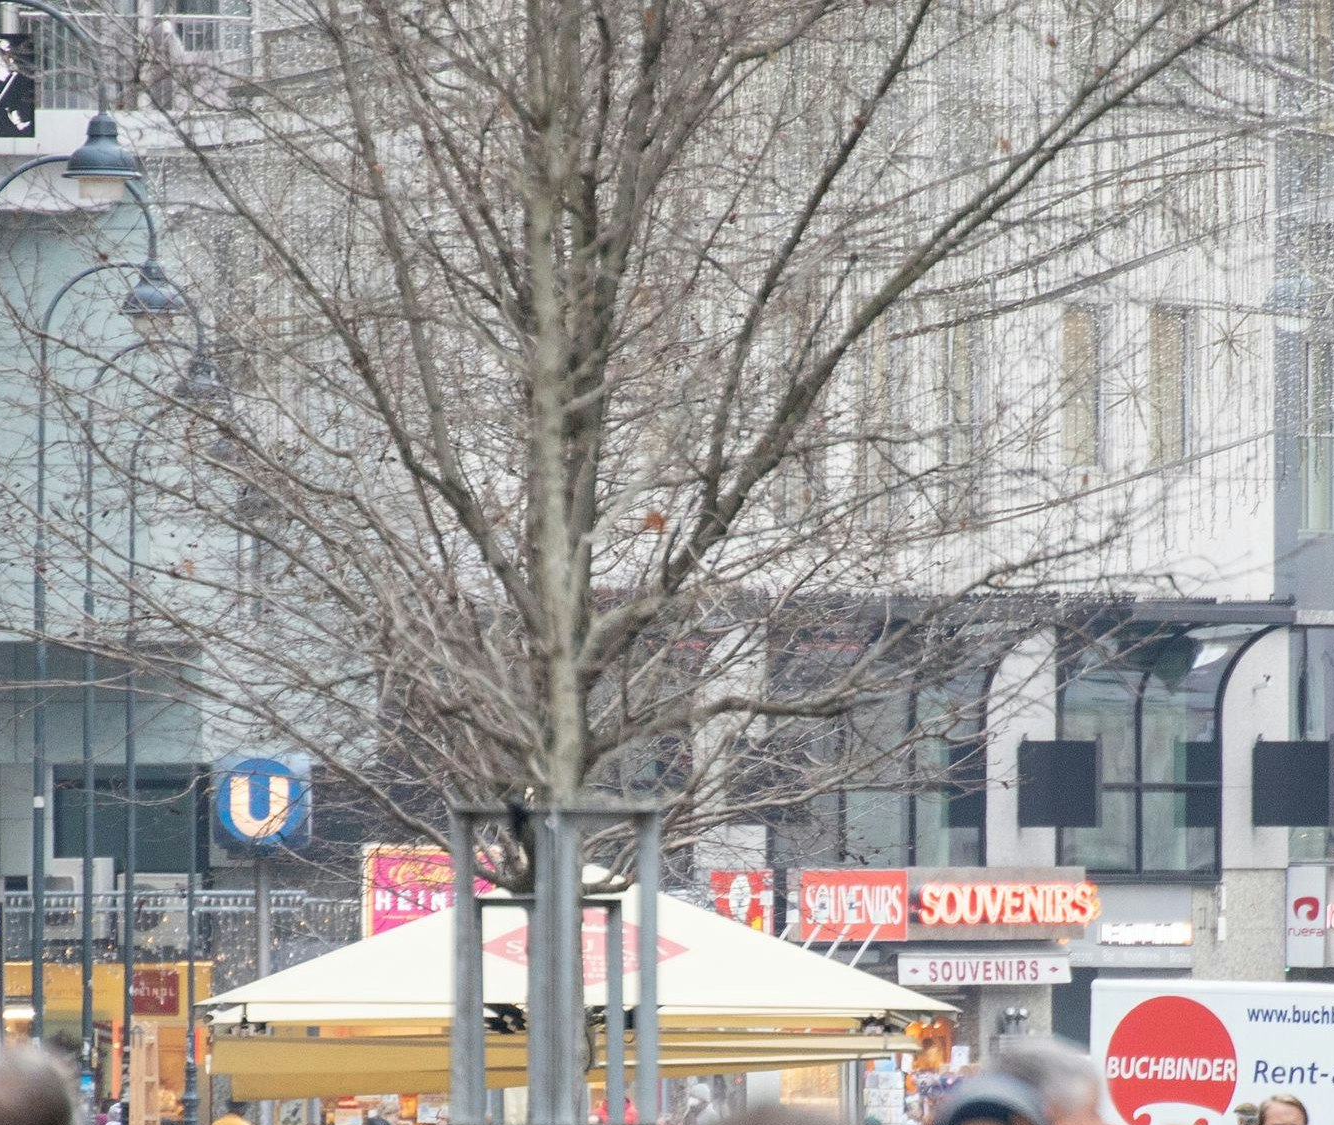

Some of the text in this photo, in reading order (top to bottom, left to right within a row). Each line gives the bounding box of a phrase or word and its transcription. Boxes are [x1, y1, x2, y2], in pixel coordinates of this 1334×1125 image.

[230, 776, 288, 838] U
[805, 882, 1099, 927] SOUVENIRS SOUVENIRS
[928, 960, 1040, 982] SOUVENIRS
[1106, 1055, 1237, 1083] BUCHBINDER
